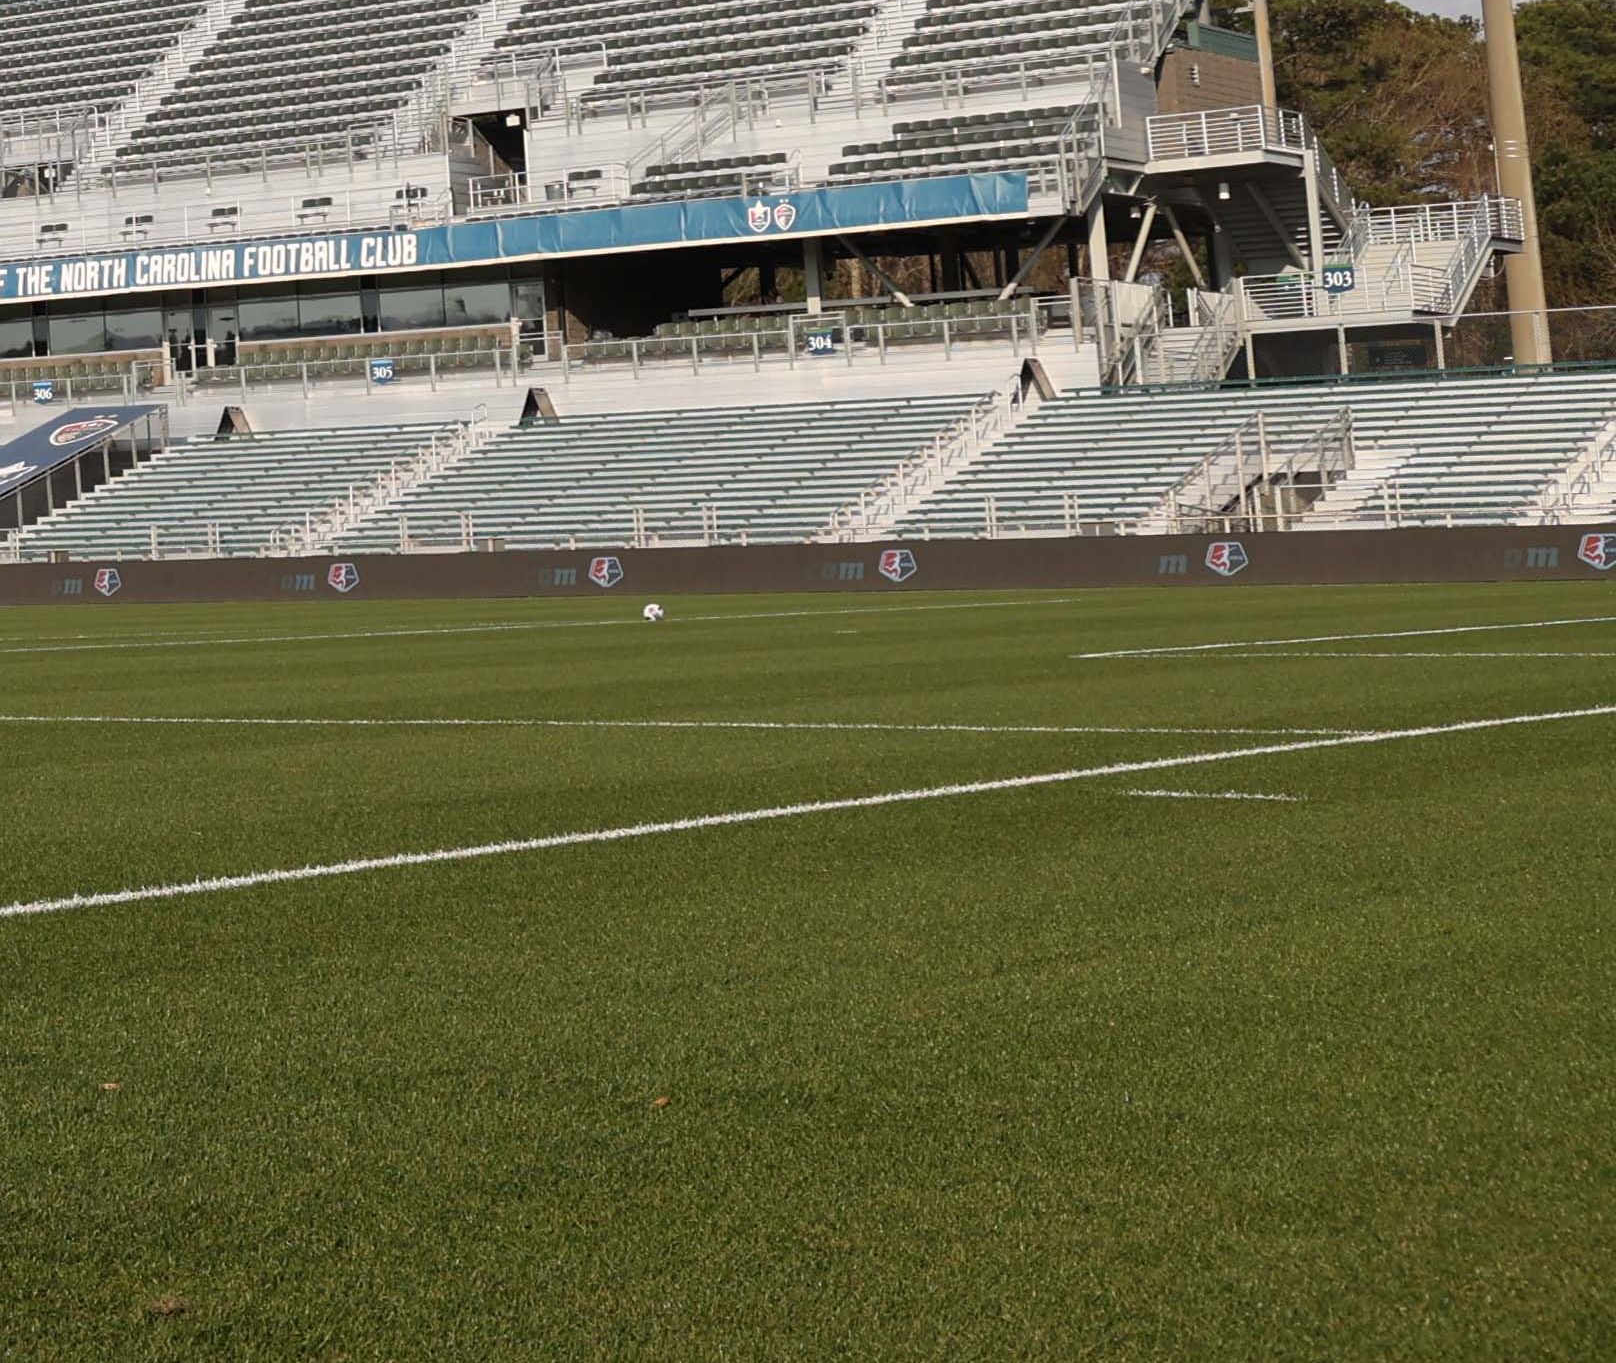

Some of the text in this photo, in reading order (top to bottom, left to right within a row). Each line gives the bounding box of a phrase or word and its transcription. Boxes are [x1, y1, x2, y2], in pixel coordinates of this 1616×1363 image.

[16, 265, 54, 296] THE
[61, 258, 127, 292] NORTH
[136, 249, 236, 286] CAROLINA
[243, 239, 351, 278] FOOTBALL
[360, 234, 417, 268] CLUB
[1324, 271, 1352, 288] 303
[808, 335, 833, 351] 304
[373, 366, 393, 380] 305
[33, 388, 53, 401] 306
